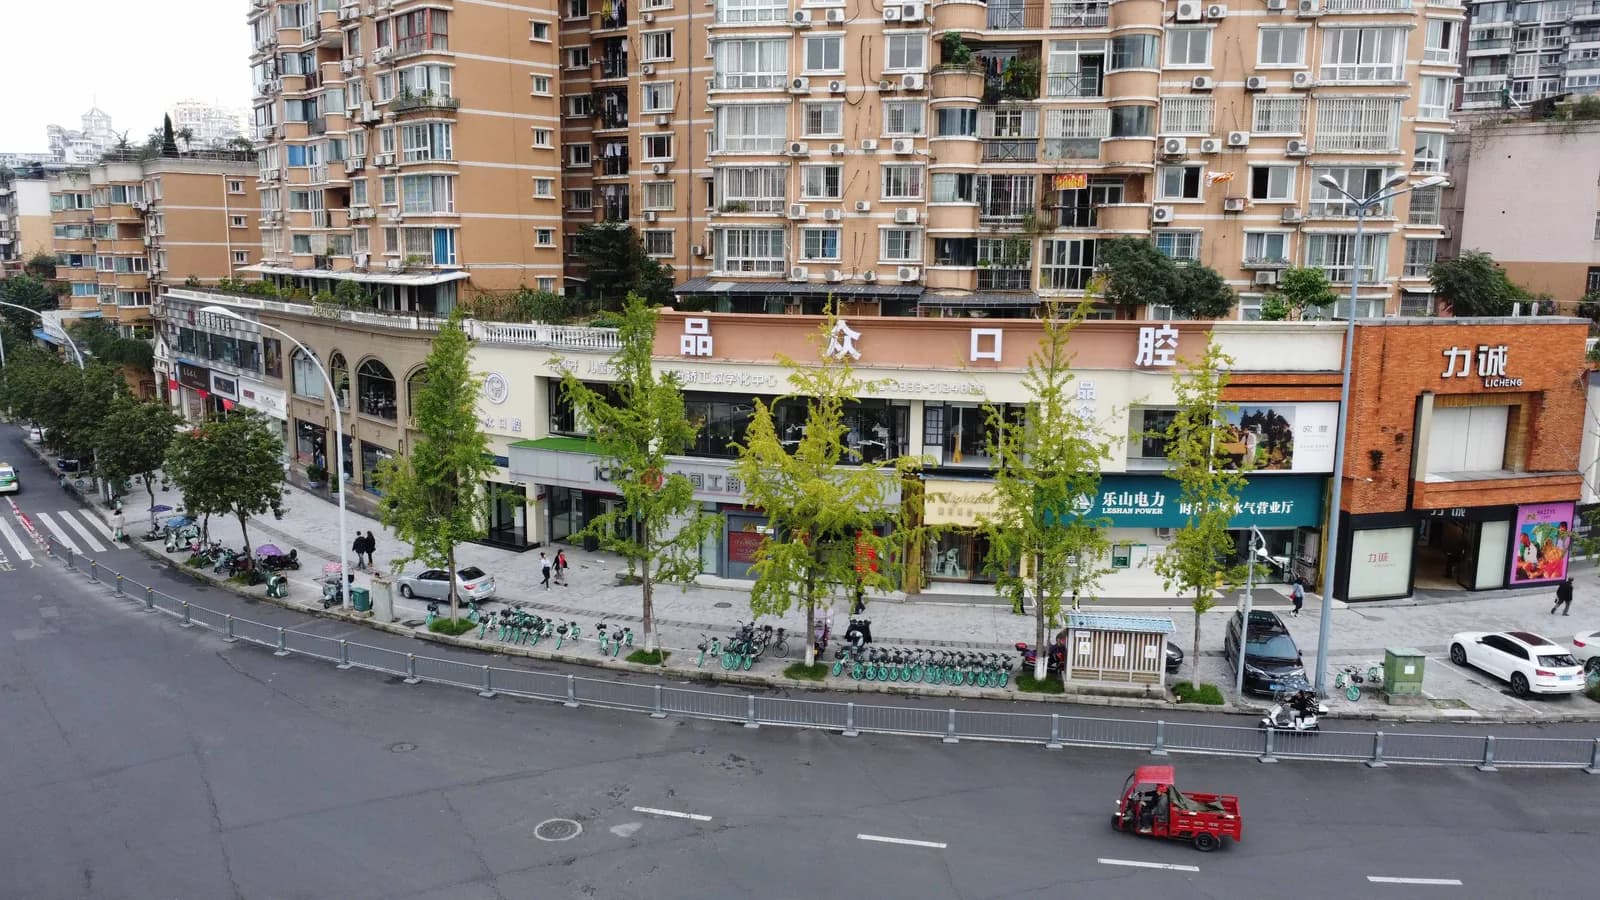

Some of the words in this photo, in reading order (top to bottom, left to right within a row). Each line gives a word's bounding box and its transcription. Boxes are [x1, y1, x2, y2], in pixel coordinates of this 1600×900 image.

[680, 317, 1180, 367] 品众口腔
[1441, 345, 1508, 378] 力诚
[1485, 378, 1524, 388] LICHENG
[1102, 491, 1165, 507] 乐山电力
[1135, 507, 1164, 515] POWER
